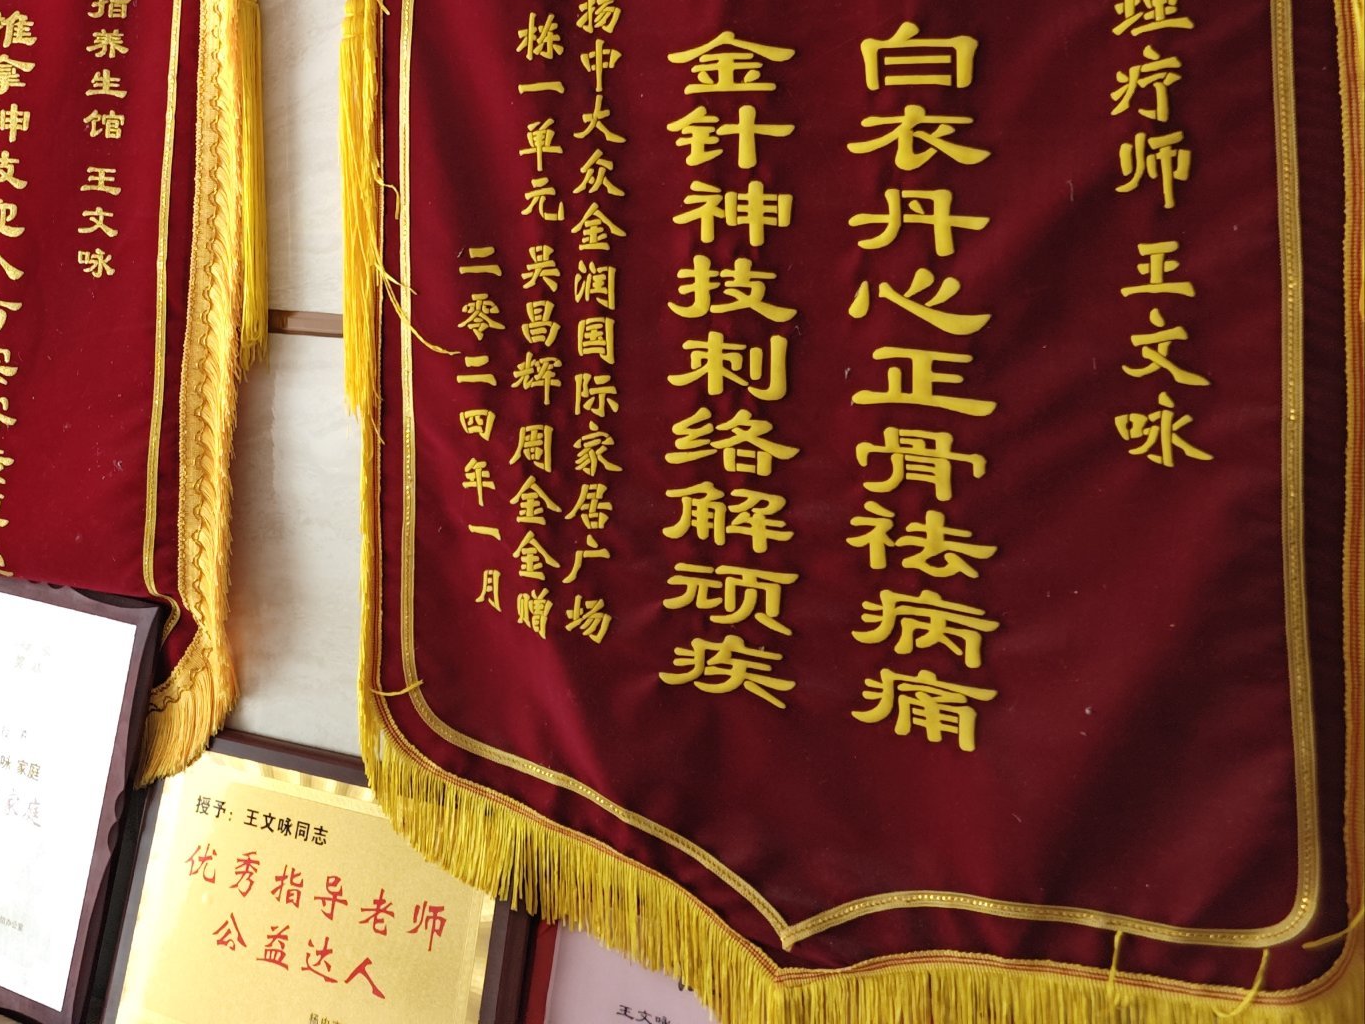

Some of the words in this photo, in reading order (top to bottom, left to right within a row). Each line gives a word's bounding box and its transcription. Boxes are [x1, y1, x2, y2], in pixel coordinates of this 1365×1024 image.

[78, 167, 121, 278] 王文咏
[1115, 241, 1212, 467] 王文咏
[457, 247, 505, 611] 二零二四年一月
[184, 842, 447, 952] 优秀指导老师
[212, 912, 386, 1000] 公益达人
